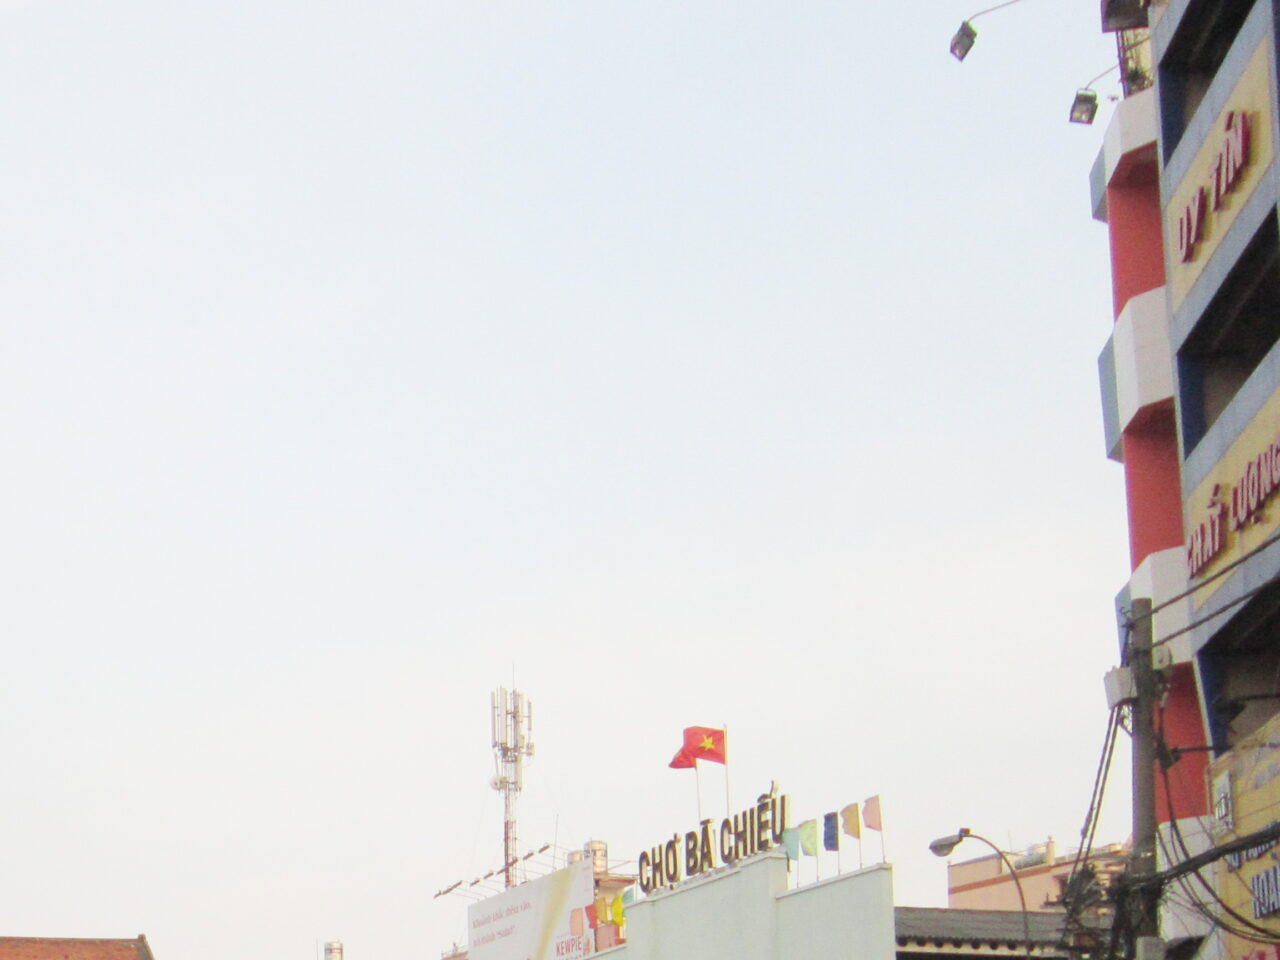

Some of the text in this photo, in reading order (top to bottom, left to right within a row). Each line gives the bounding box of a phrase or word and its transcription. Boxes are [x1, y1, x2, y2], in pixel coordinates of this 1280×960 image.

[639, 832, 681, 894] CHỢ
[685, 818, 717, 877] BÀ
[556, 936, 582, 956] KEWPIE
